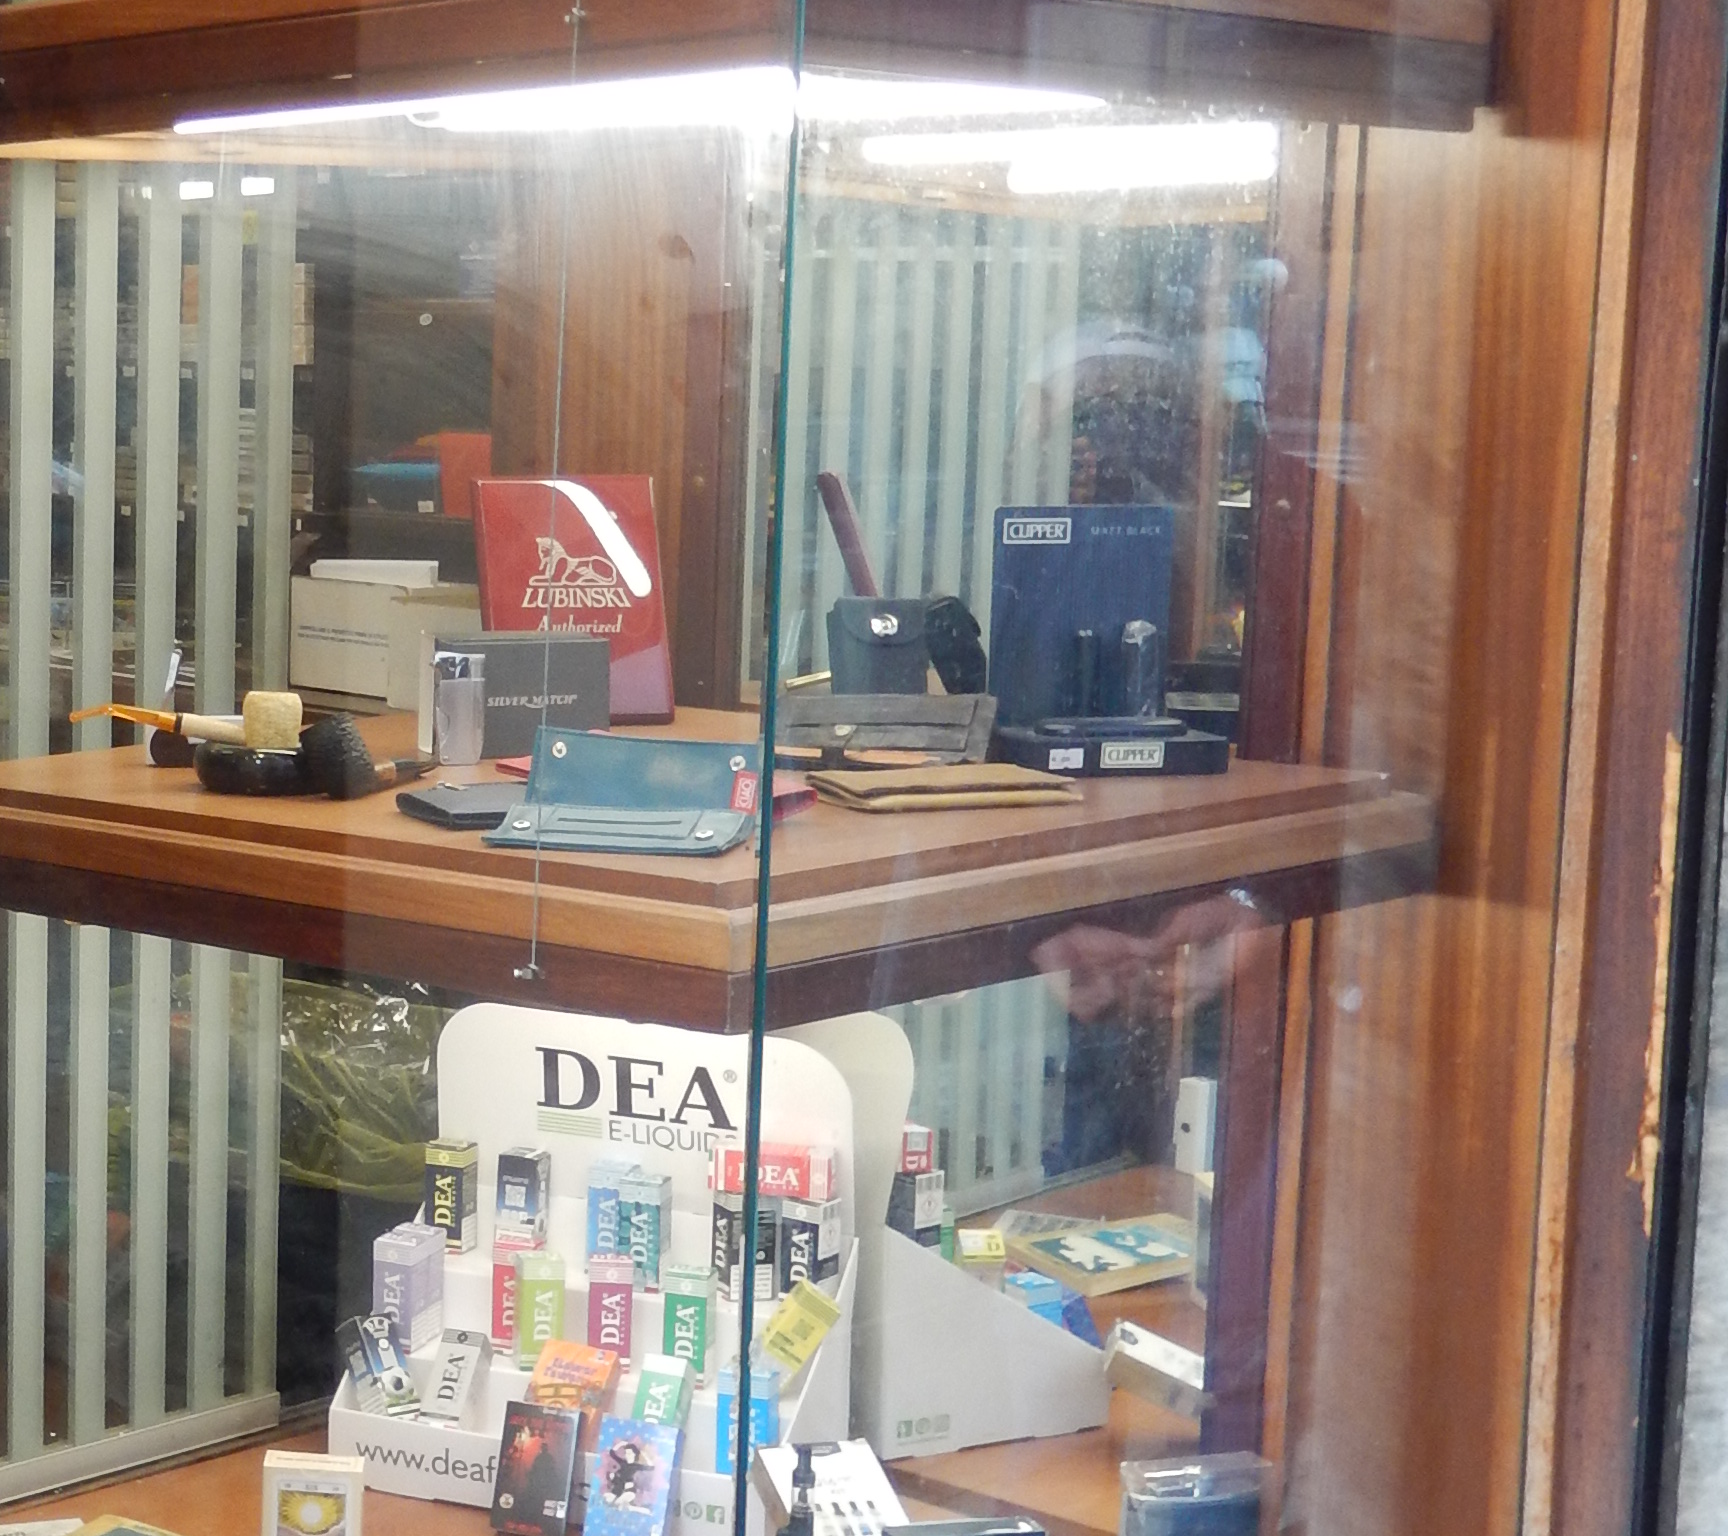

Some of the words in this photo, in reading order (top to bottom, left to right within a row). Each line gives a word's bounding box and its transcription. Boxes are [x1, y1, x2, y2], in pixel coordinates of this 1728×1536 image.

[1009, 522, 1066, 539] CLIPPER
[521, 587, 632, 608] LUBINSKI
[537, 614, 623, 633] Authorized
[486, 695, 528, 707] SILVER
[532, 694, 576, 707] MATCH
[1106, 748, 1159, 763] CLIPPER
[535, 1046, 738, 1132] DEA
[434, 1175, 453, 1227] DEA
[597, 1198, 616, 1252] DEA
[630, 1212, 649, 1263] DEA
[715, 1217, 729, 1268] DEA
[789, 1230, 810, 1282] DEA
[384, 1274, 401, 1324] DEA
[534, 1290, 554, 1341] DEA
[600, 1294, 622, 1345] DEA
[674, 1306, 696, 1359] DEA
[437, 1355, 465, 1401] DEA
